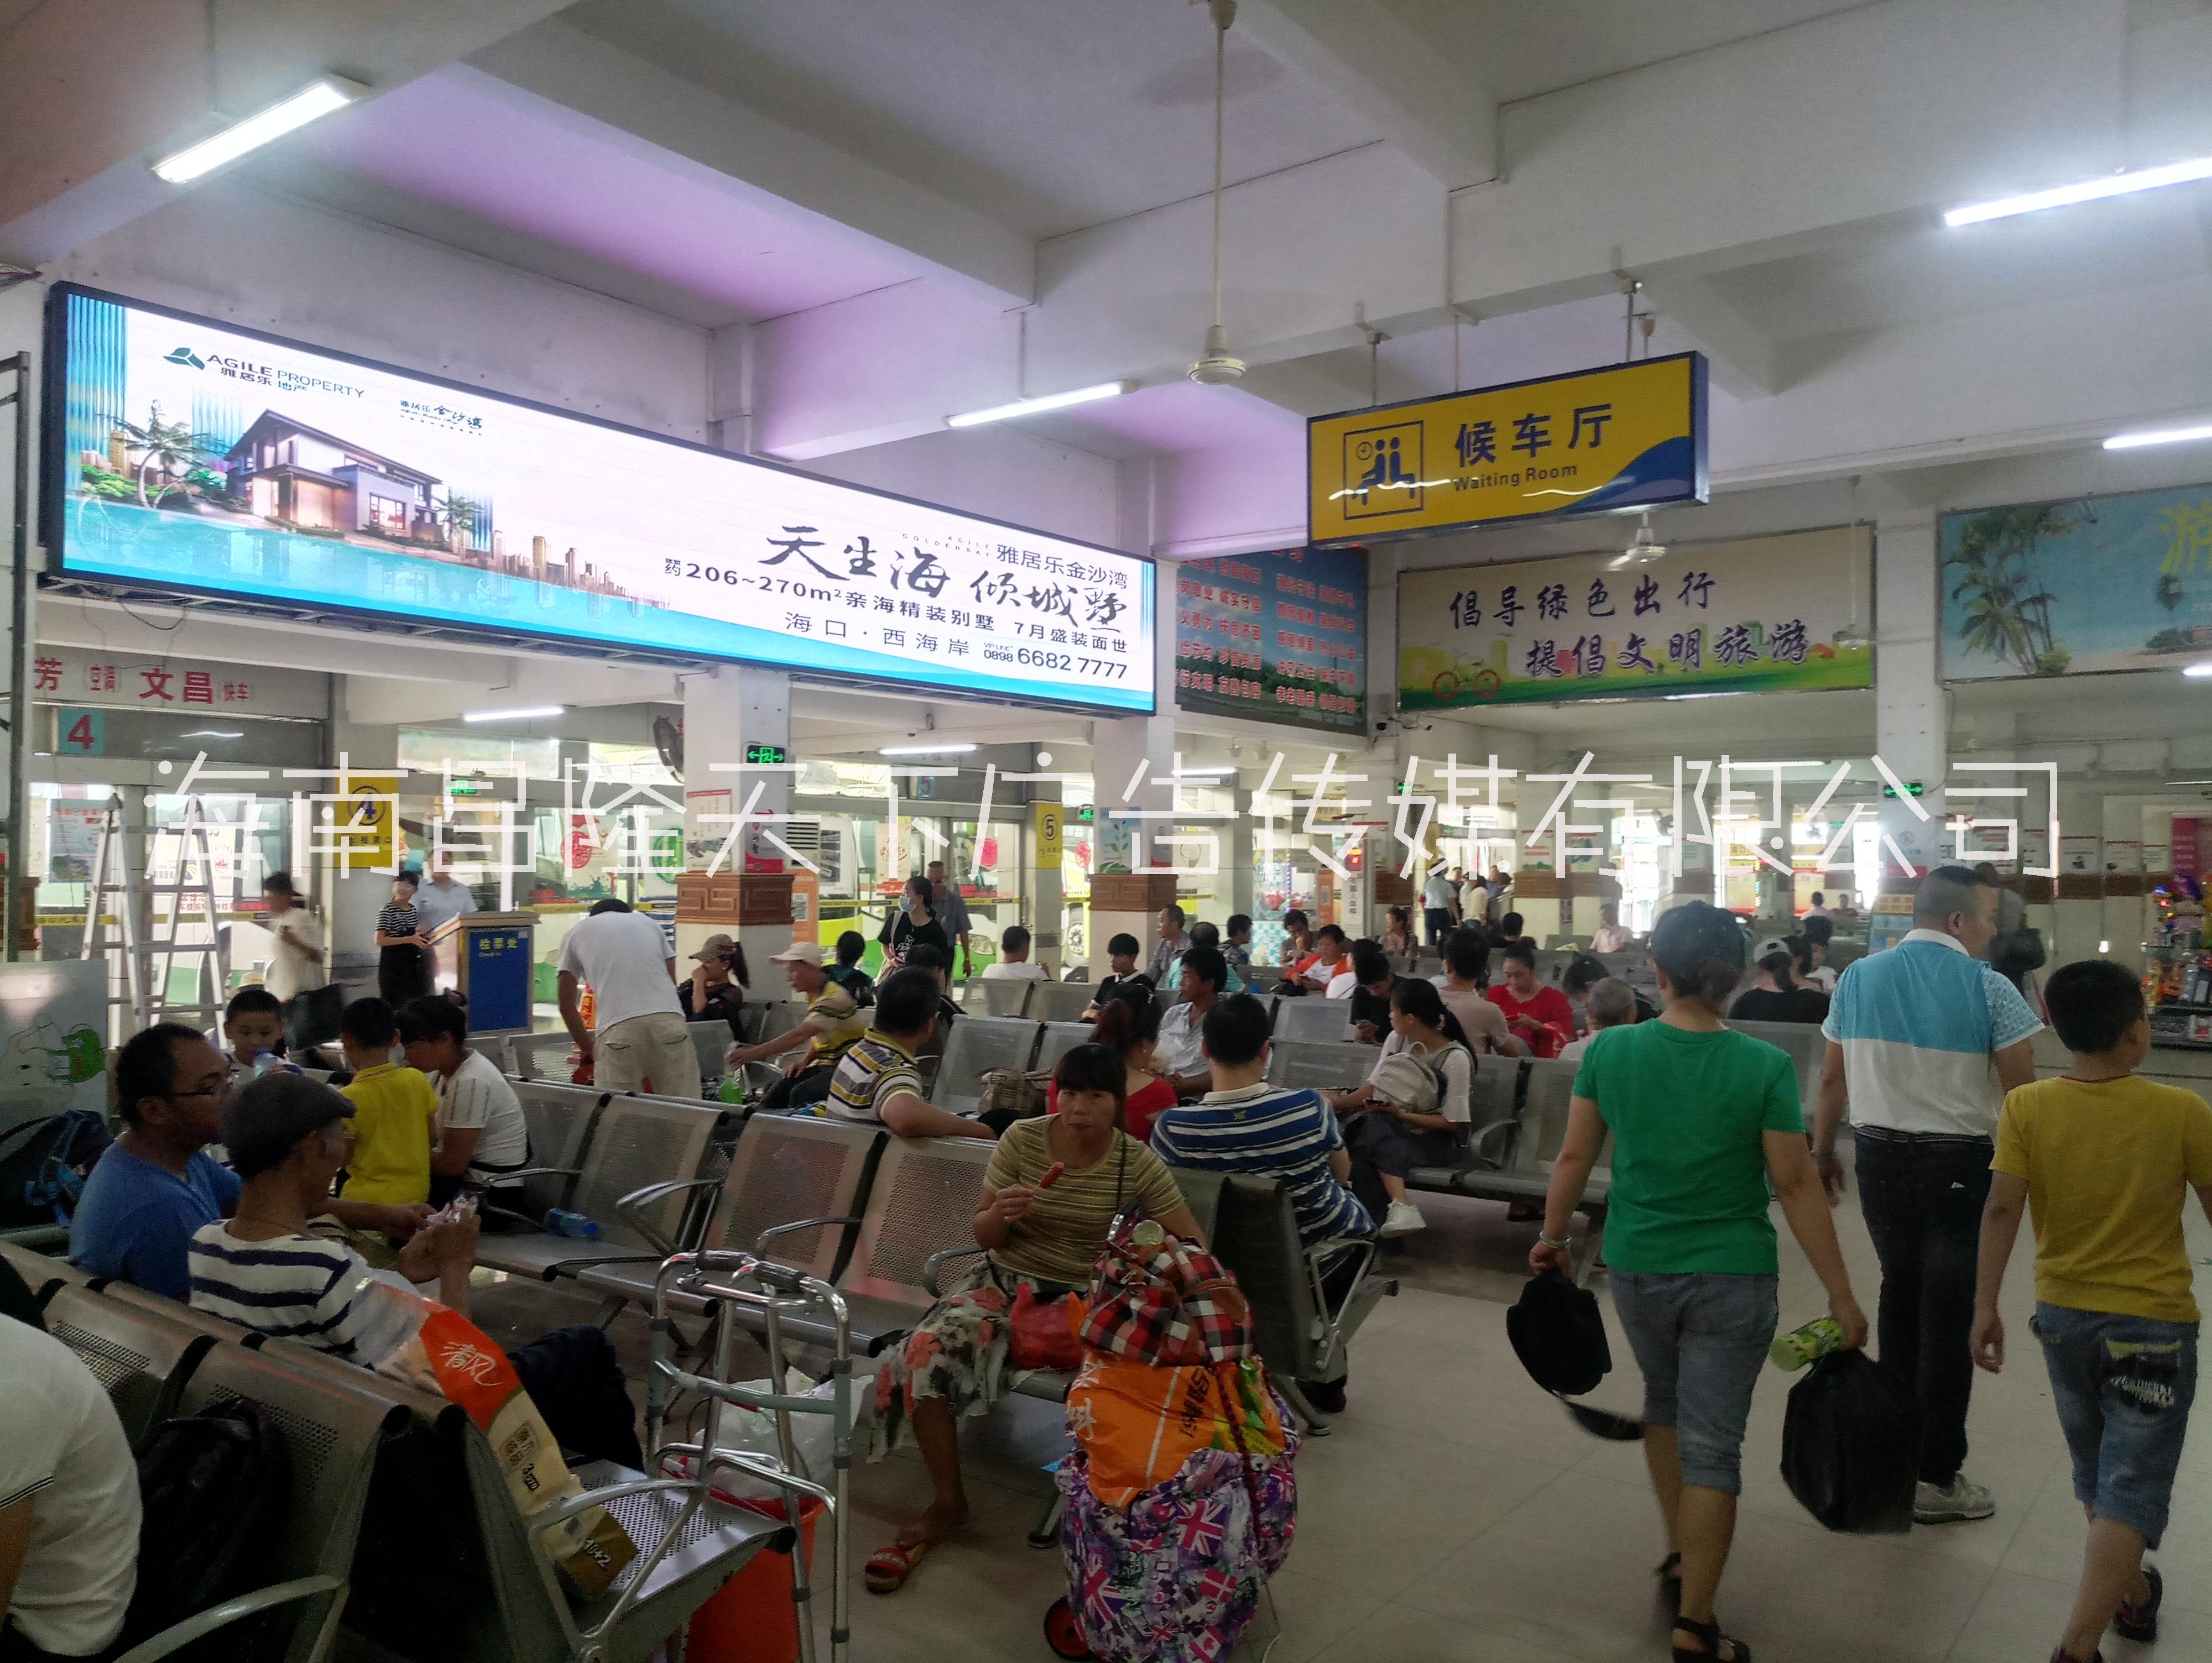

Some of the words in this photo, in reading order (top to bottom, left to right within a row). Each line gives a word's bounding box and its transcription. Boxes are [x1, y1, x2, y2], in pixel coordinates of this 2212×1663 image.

[207, 354, 273, 376] AGILE
[278, 370, 365, 398] PROPERTY
[221, 367, 273, 386] 雅居乐
[278, 380, 307, 392] 地产
[1454, 403, 1612, 468] 候车厅
[1453, 473, 1520, 491] Waiting
[1525, 463, 1578, 482] Room
[996, 544, 1128, 590] 雅居乐金沙湾
[1449, 571, 1717, 630] 倡导绿色出行
[1014, 621, 1128, 653] 7月盛装面世
[1525, 617, 1811, 679] 提倡文明旅游
[984, 649, 1014, 662] 0898
[1018, 647, 1071, 671] 6682
[1077, 657, 1128, 679] 7777
[138, 667, 213, 704] 文昌
[67, 714, 95, 750] 4
[357, 792, 377, 820] 4
[1046, 818, 1054, 837] 5
[440, 1340, 504, 1387] 清风
